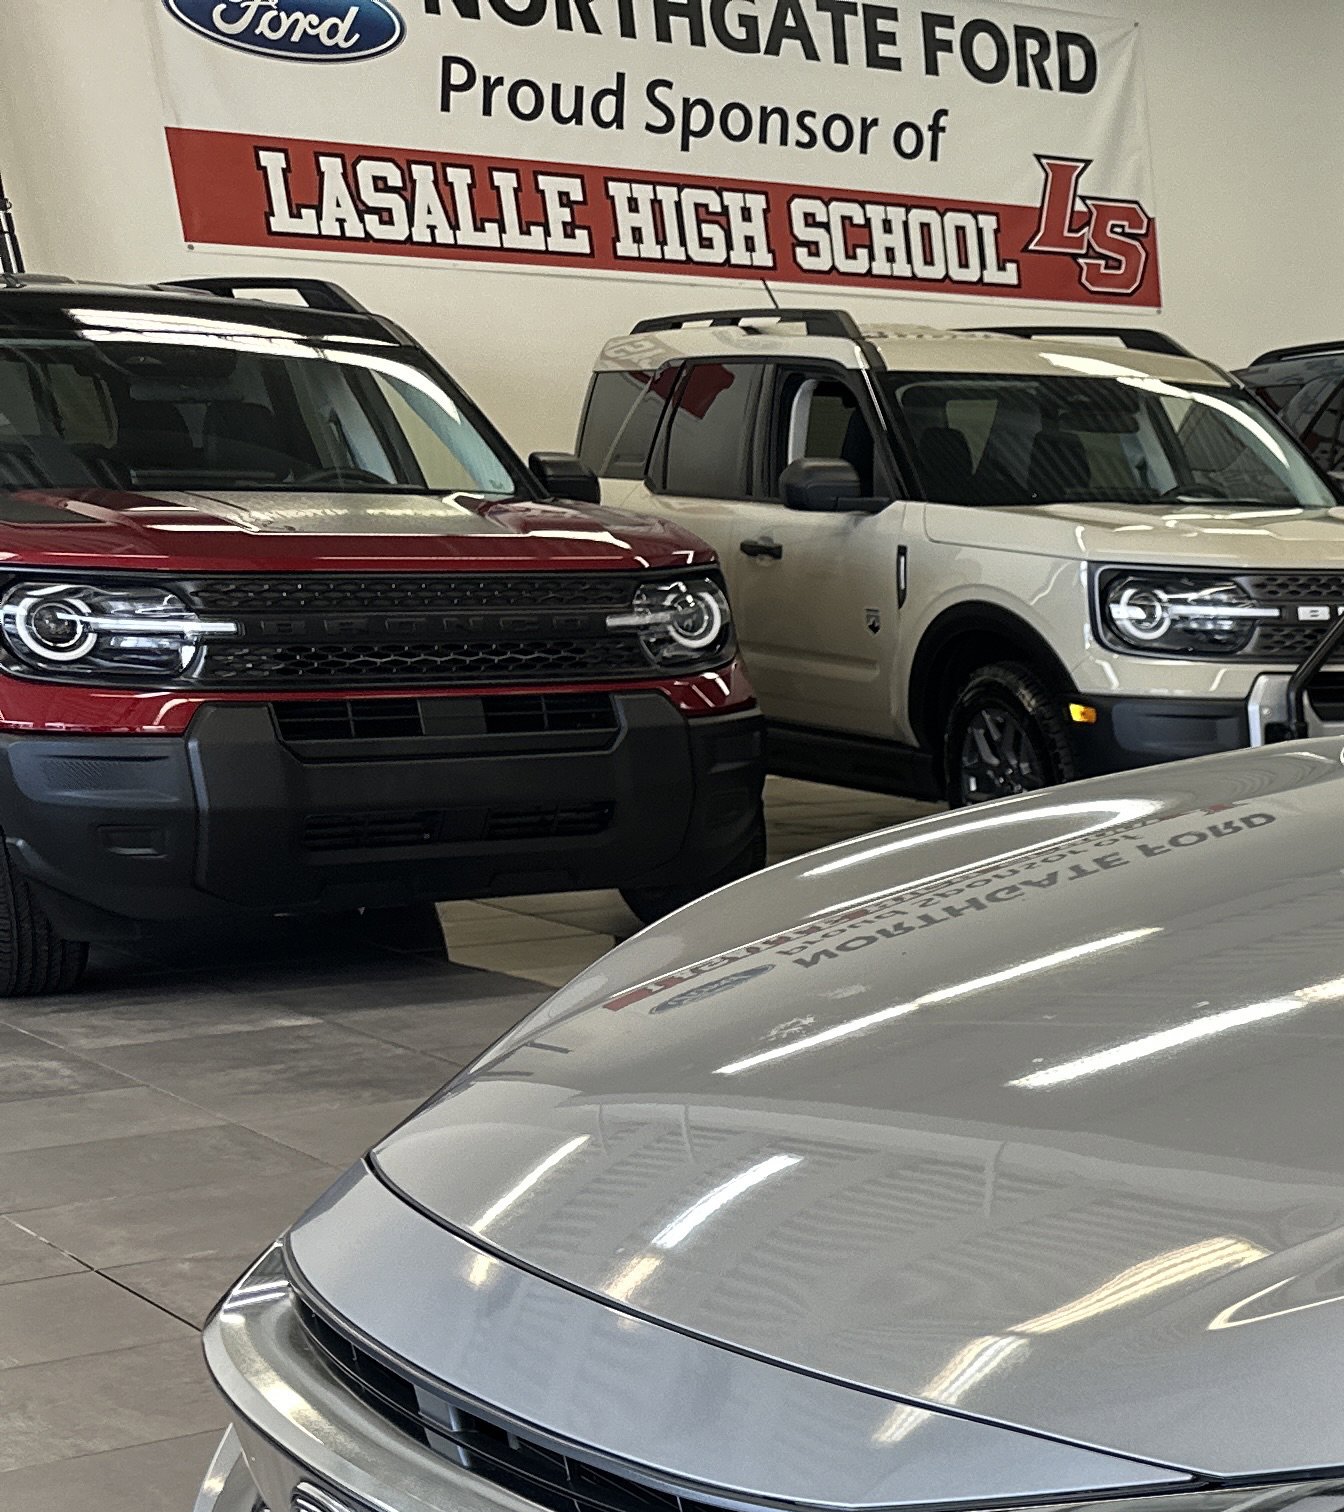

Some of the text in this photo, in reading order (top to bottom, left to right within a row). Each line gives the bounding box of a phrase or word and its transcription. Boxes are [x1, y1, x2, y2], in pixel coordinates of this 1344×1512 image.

[211, 0, 361, 49] Ford
[422, 0, 1098, 95] THGATE FORD
[440, 55, 949, 162] Proud Sponsor of
[254, 145, 1021, 287] LASALLE HIGH SCHOOL
